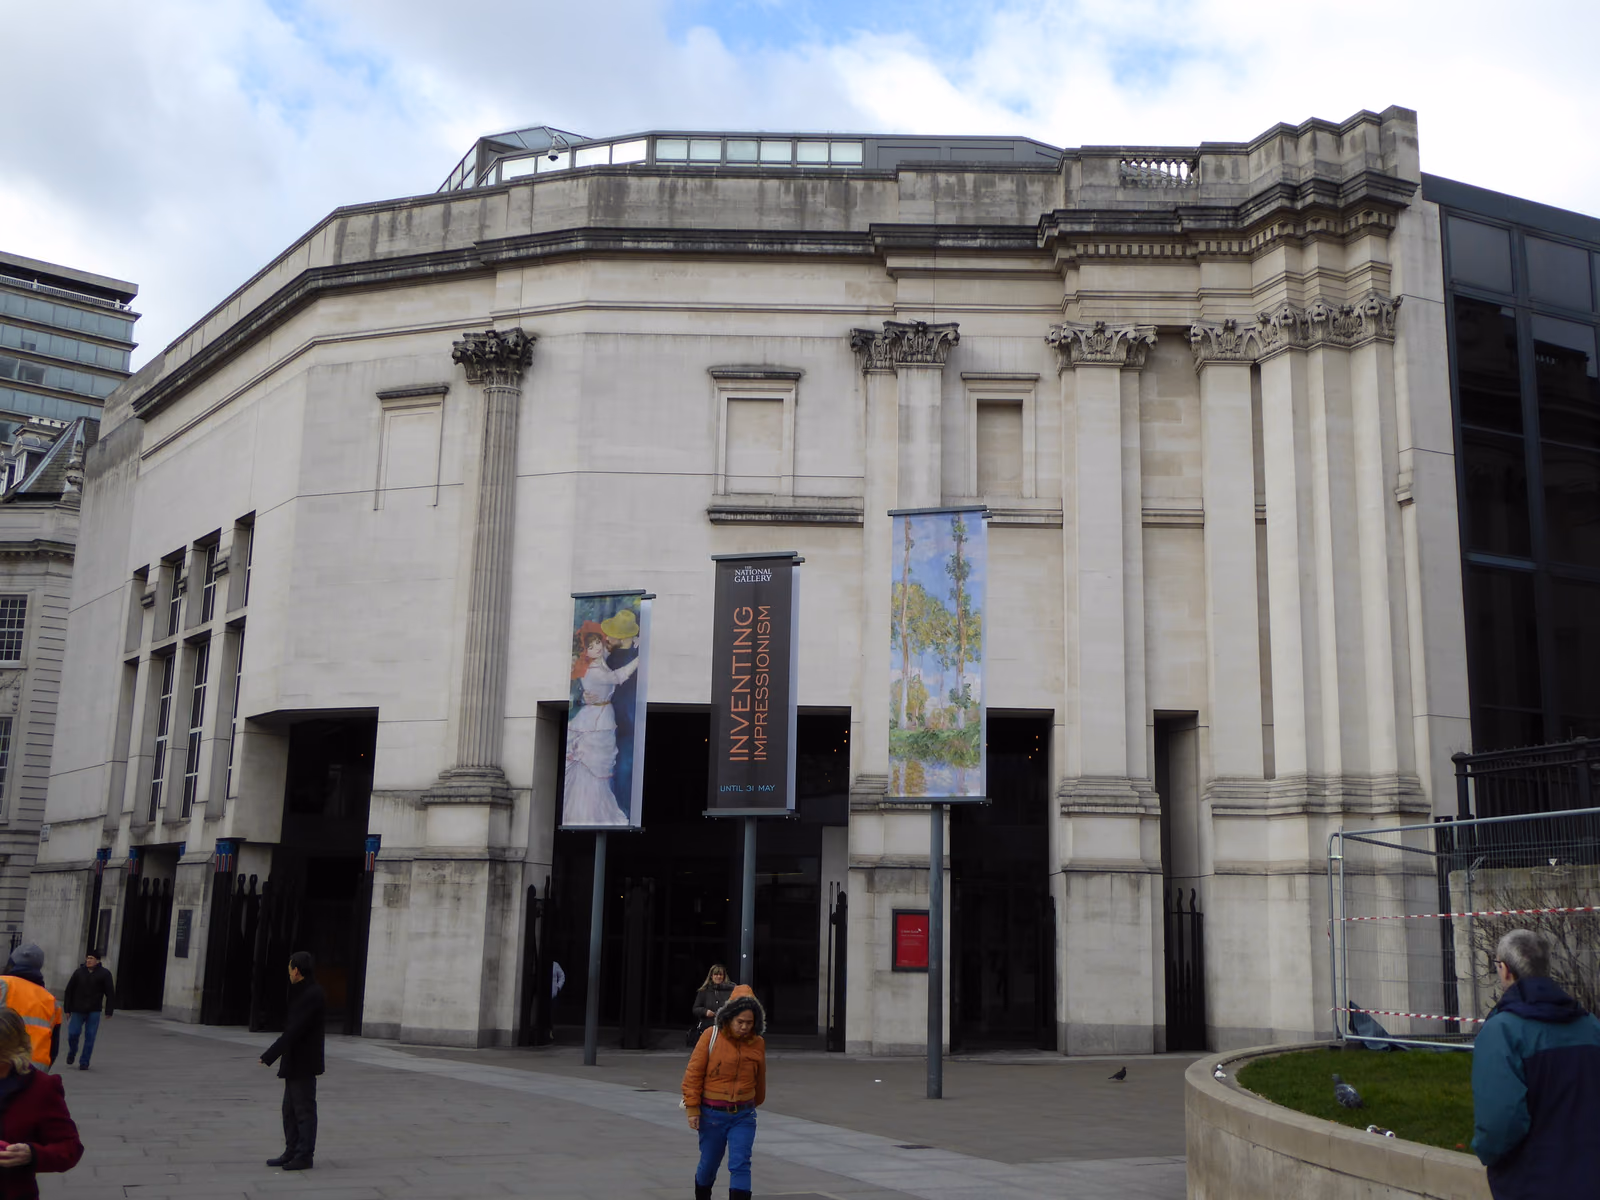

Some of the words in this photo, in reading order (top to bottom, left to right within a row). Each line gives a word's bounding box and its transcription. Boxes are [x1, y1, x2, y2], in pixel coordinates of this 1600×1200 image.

[735, 568, 772, 576] NATIONAL
[734, 575, 772, 583] GALLERY
[729, 606, 753, 761] INVENTING
[753, 605, 771, 761] IMPRESSIONISM
[720, 784, 743, 792] UNTIL
[758, 784, 776, 792] MAY
